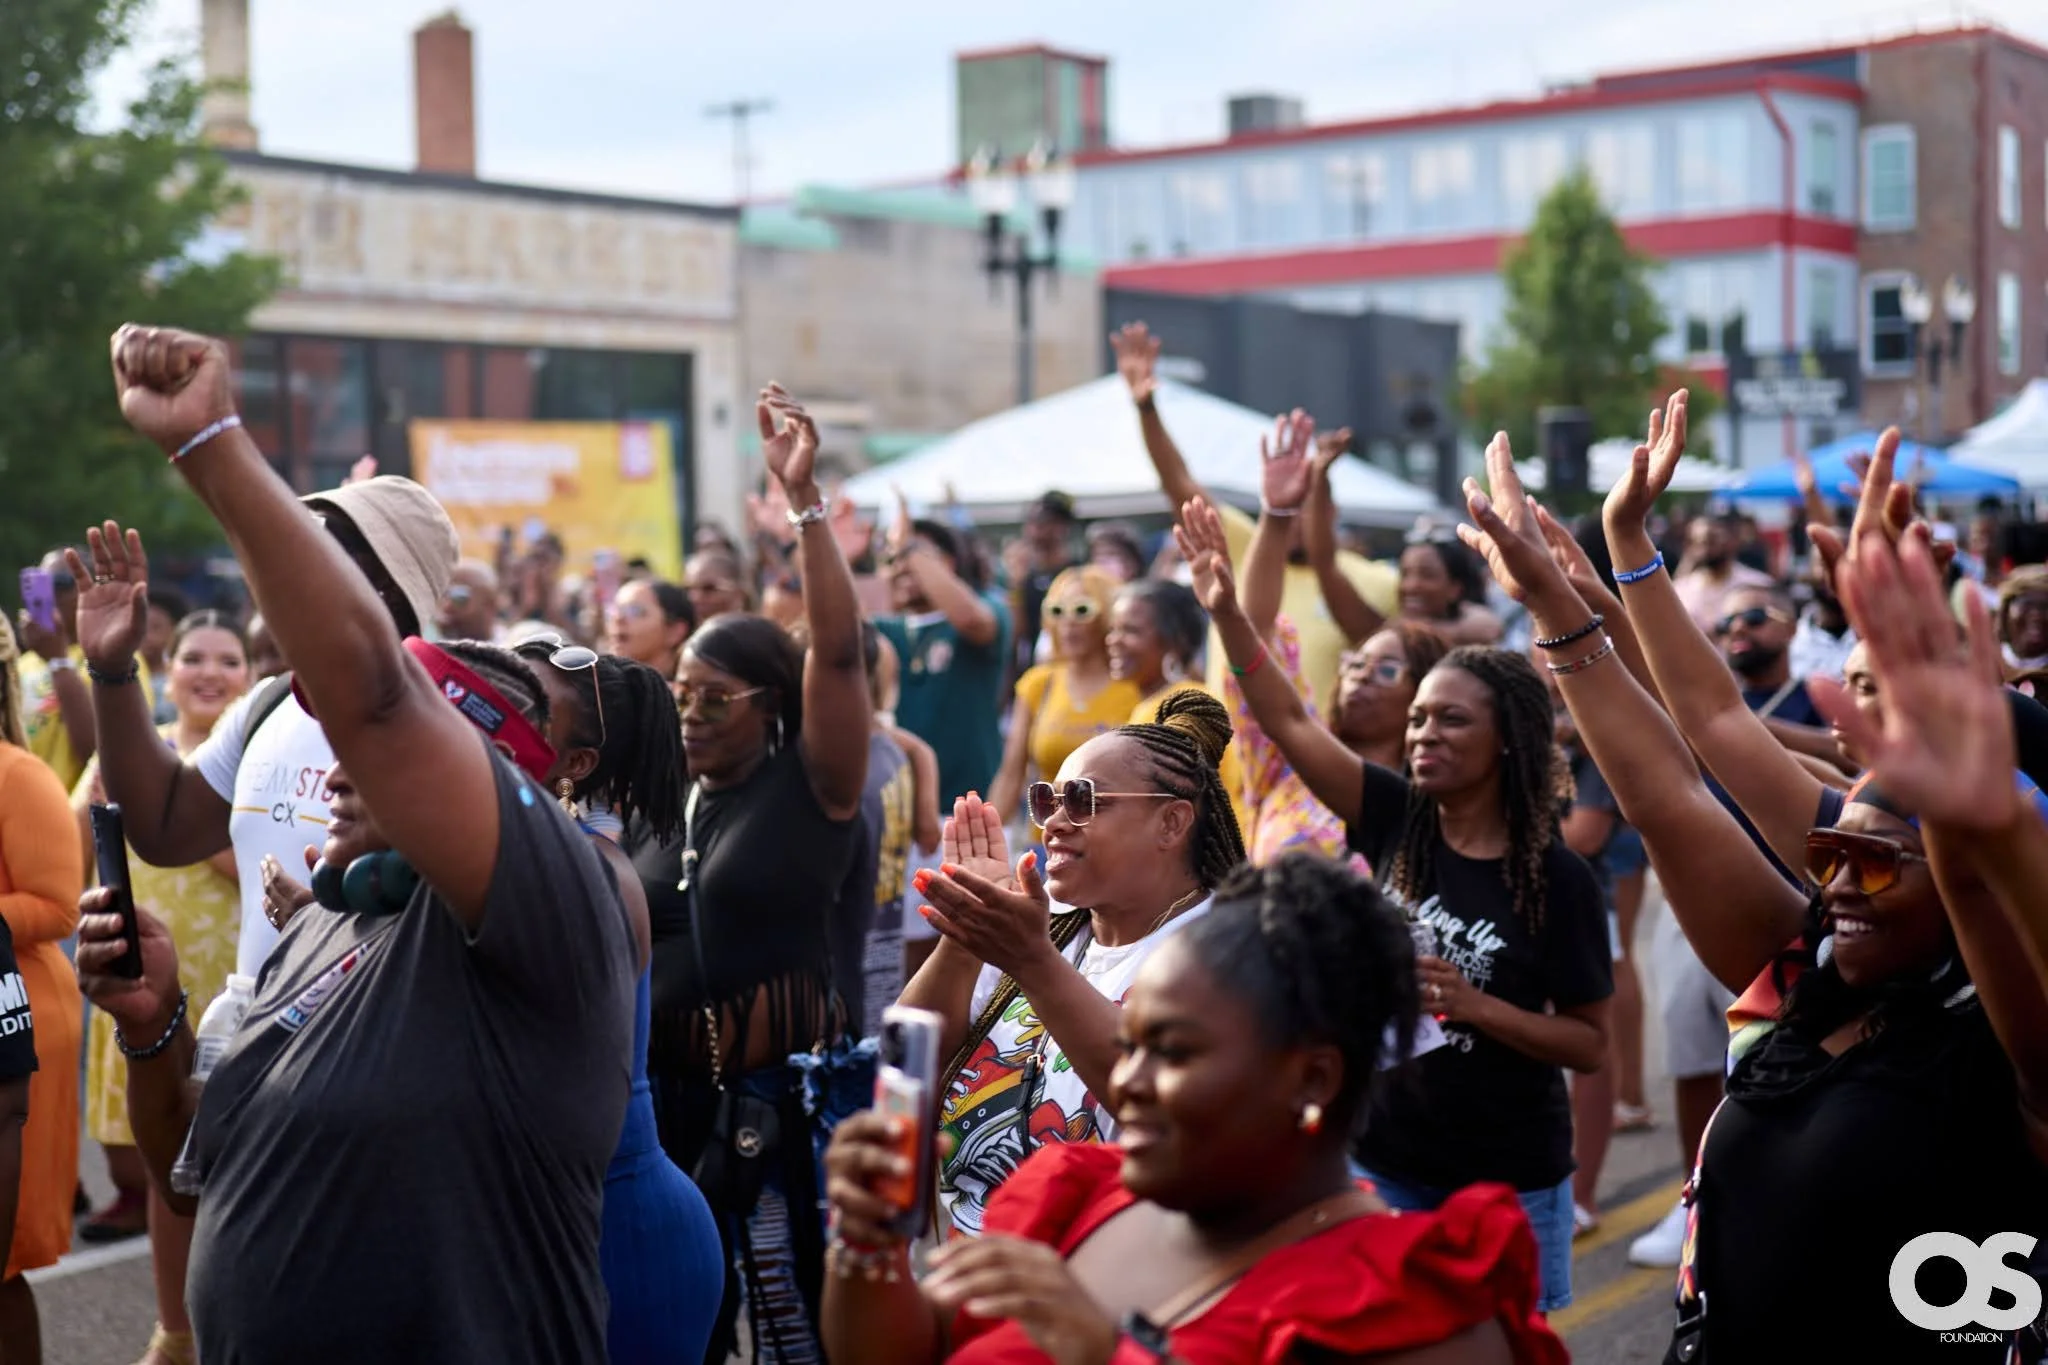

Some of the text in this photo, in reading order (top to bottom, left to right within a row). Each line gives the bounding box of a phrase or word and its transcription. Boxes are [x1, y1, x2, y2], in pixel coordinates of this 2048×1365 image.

[272, 801, 296, 828] CX
[1466, 918, 1508, 957] Up
[0, 1011, 32, 1038] DIT
